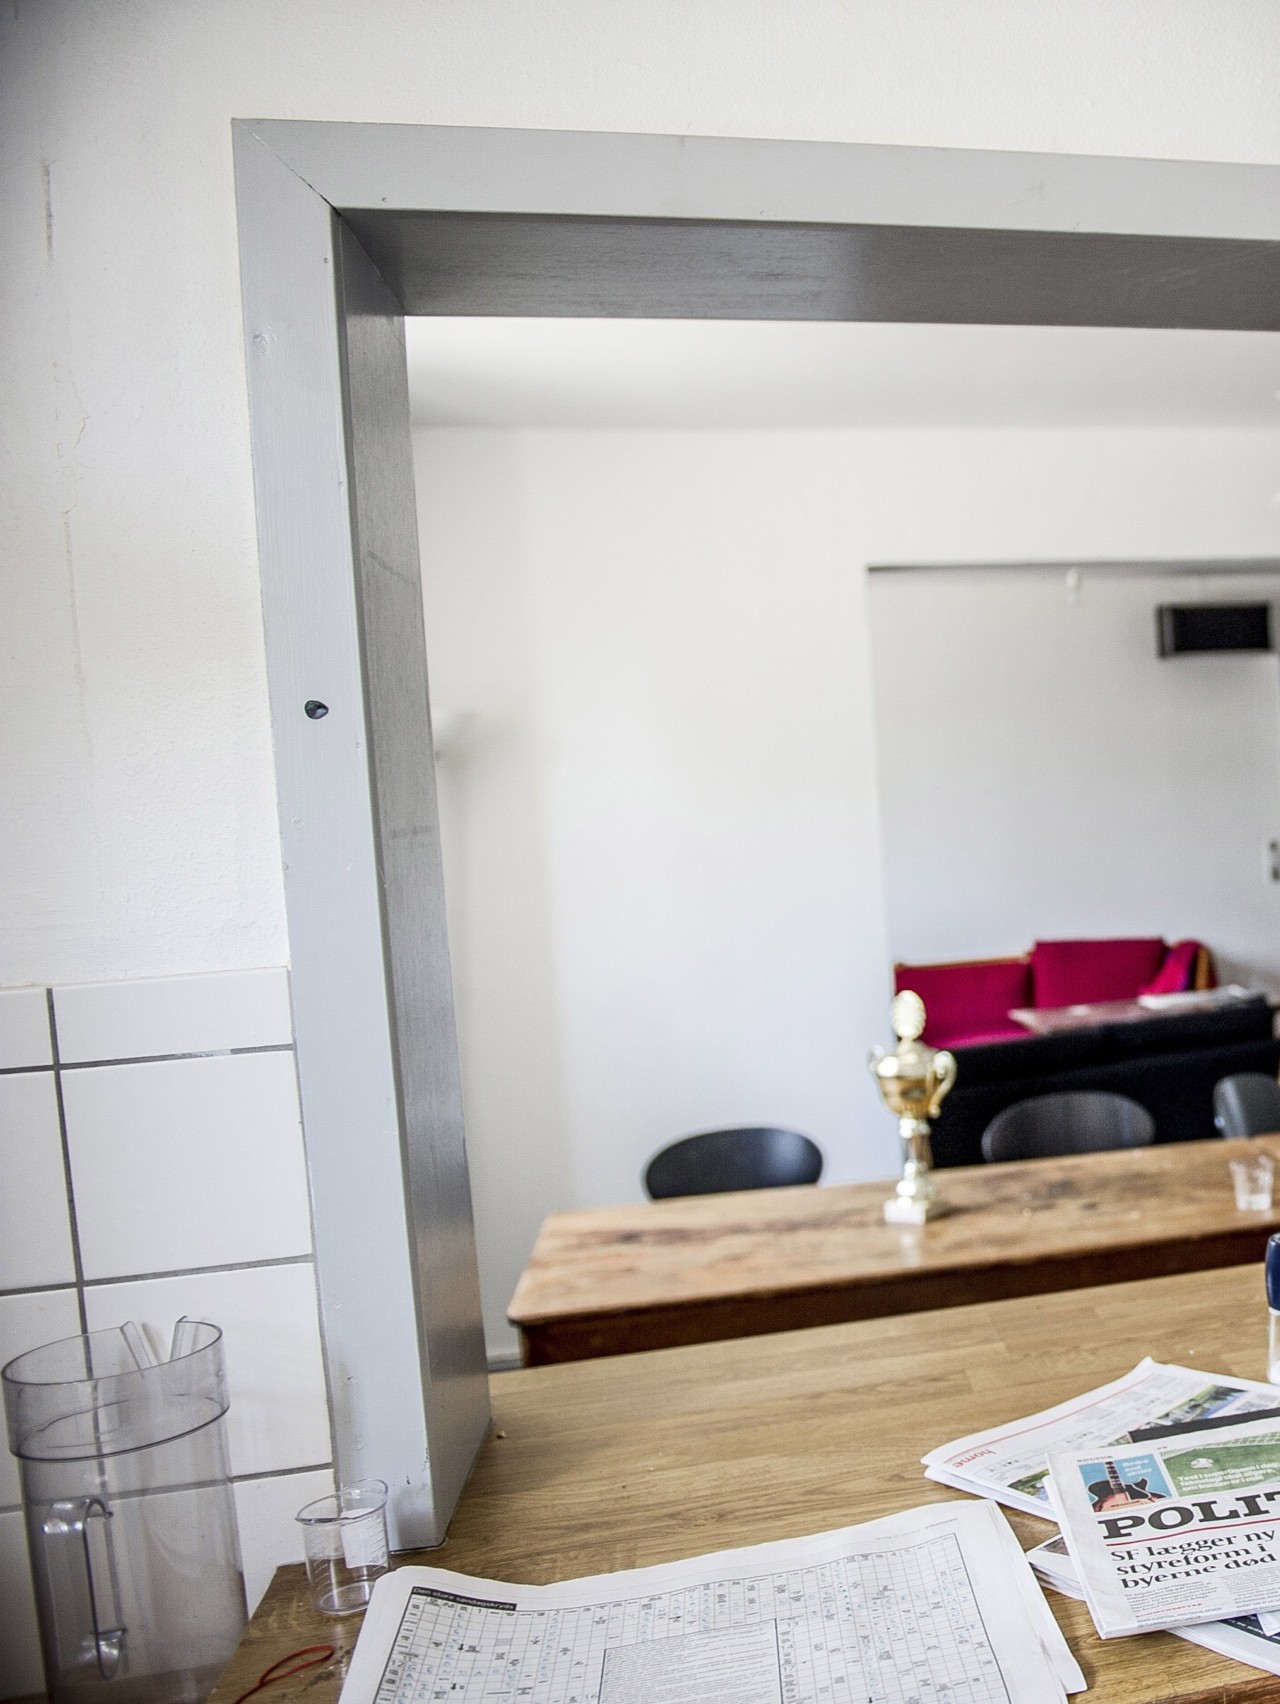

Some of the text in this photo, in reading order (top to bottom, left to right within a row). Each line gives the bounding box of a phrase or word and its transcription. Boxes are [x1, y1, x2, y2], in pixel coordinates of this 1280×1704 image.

[953, 1449, 996, 1469] home
[1110, 1529, 1276, 1562] SF lægger ny
[1116, 1543, 1269, 1576] styreform i
[1120, 1564, 1219, 1589] byerne
[1224, 1553, 1278, 1570] død
[413, 1587, 430, 1596] Den
[433, 1591, 454, 1600] store
